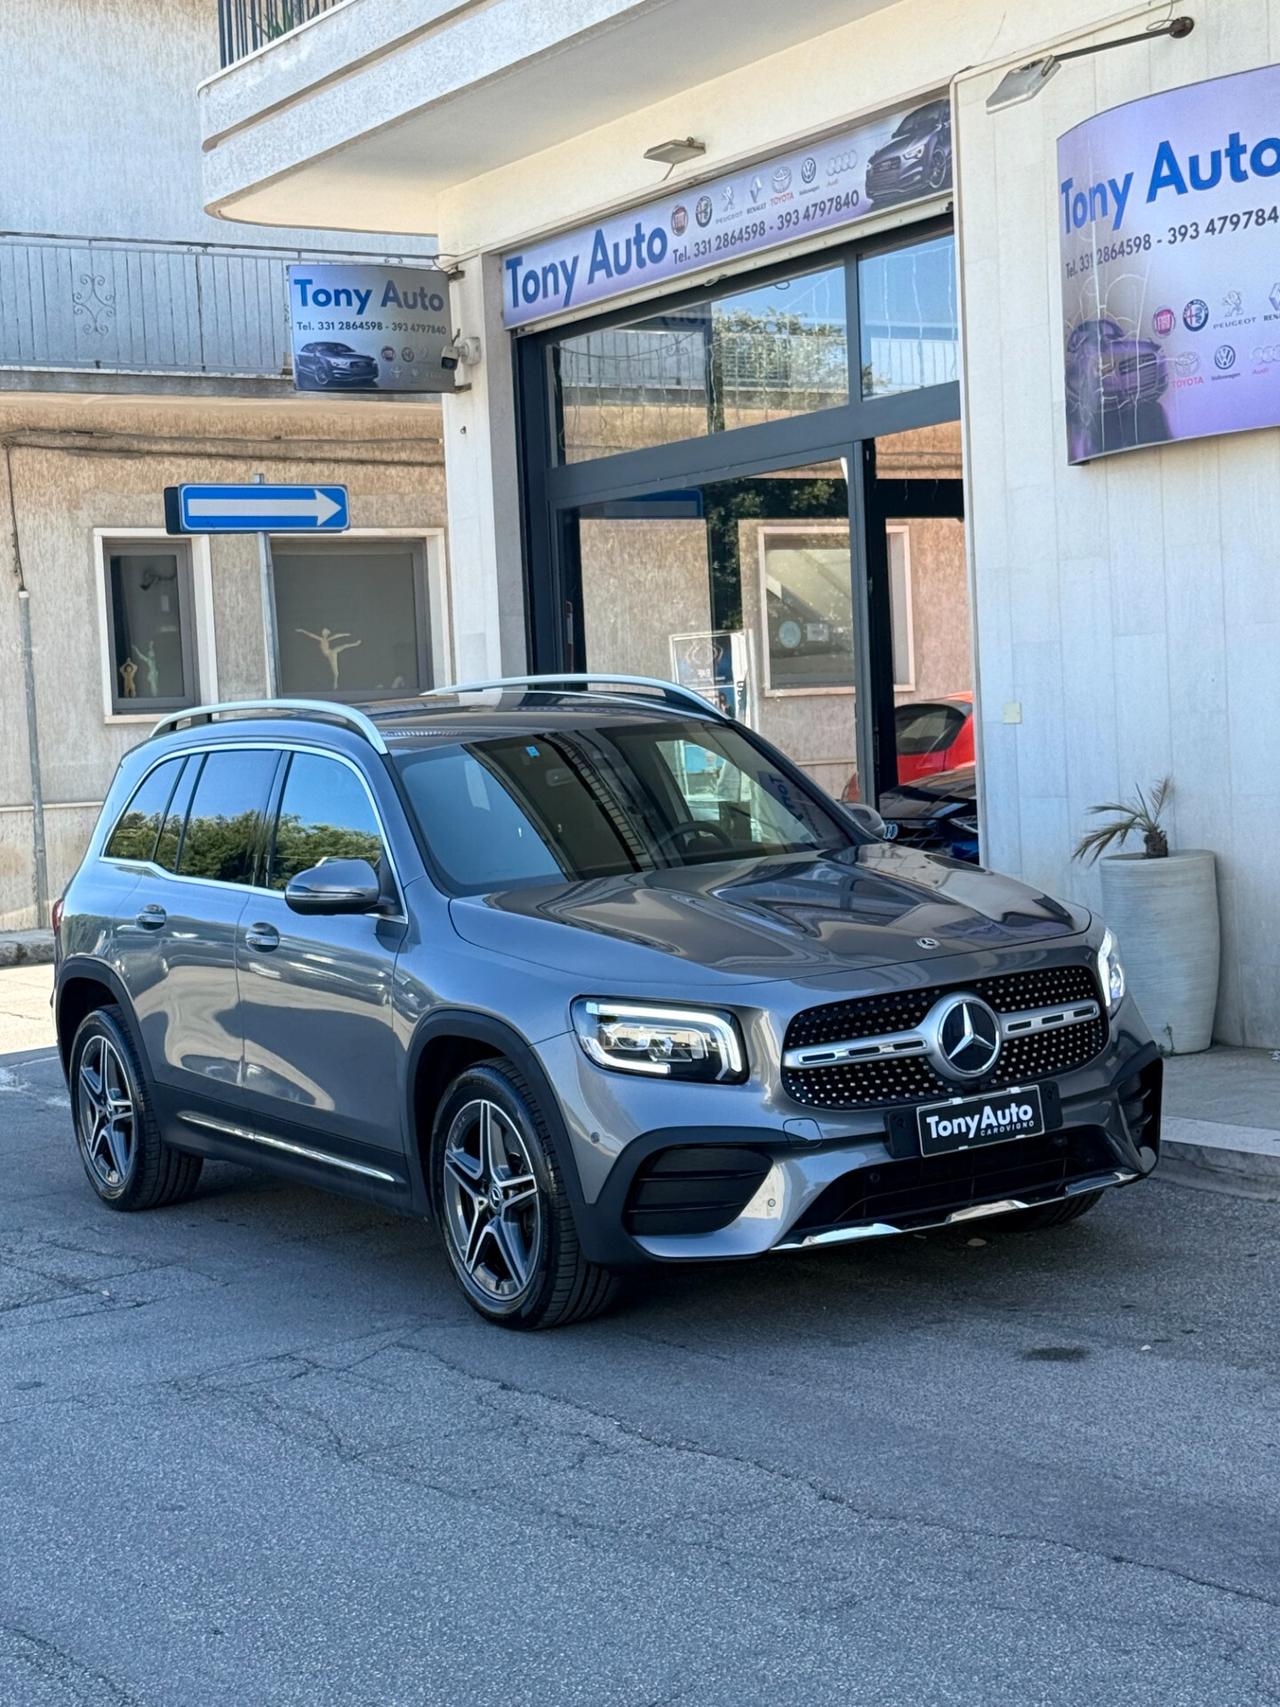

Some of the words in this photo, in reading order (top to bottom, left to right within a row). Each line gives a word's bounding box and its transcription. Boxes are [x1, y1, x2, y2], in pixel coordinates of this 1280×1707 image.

[769, 192, 795, 207] TOYOTA
[1061, 172, 1134, 234] Tony
[1146, 131, 1280, 204] Auto
[673, 249, 691, 264] Tel.
[693, 239, 712, 258] 331
[715, 220, 766, 252] 2864598
[777, 209, 800, 231] 393
[803, 189, 860, 222] 4797840
[505, 255, 580, 308] Tony
[587, 222, 668, 285] Auto
[1065, 259, 1079, 279] Tel.
[1096, 233, 1152, 266] 2864598
[1167, 222, 1200, 245] 393
[293, 278, 373, 315] Tony
[380, 280, 445, 312] Auto
[296, 321, 315, 332] Tel.
[317, 321, 335, 331] 331
[340, 321, 384, 331] 2864598
[391, 322, 409, 332] 393
[1212, 317, 1257, 329] PEUGEOT
[1263, 314, 1280, 322] REN
[1172, 376, 1205, 389] TOYOTA
[926, 1102, 1033, 1139] TonyAuto
[980, 1120, 1035, 1137] CAROVIGNO
